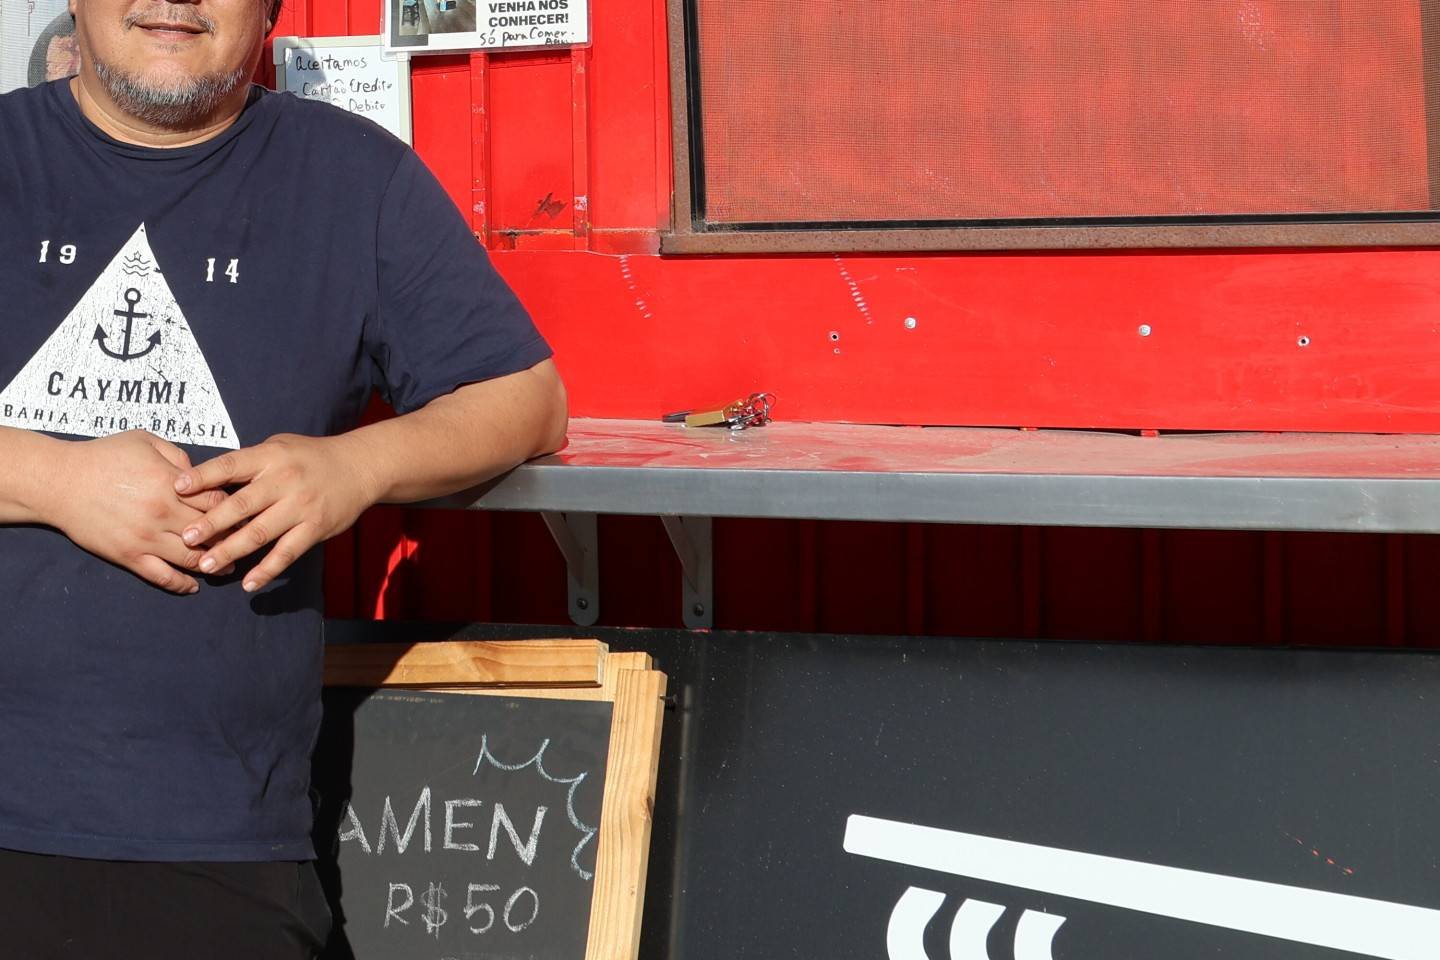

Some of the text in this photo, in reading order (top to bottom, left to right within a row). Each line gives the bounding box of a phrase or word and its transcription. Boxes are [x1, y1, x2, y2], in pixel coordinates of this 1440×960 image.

[488, 0, 569, 13] VENHA NOS
[488, 12, 569, 28] CONHECER!
[39, 240, 77, 265] 19
[206, 258, 239, 284] 14
[47, 371, 187, 404] CAYMMI
[4, 404, 229, 439] BAHIA RIO BRASIL
